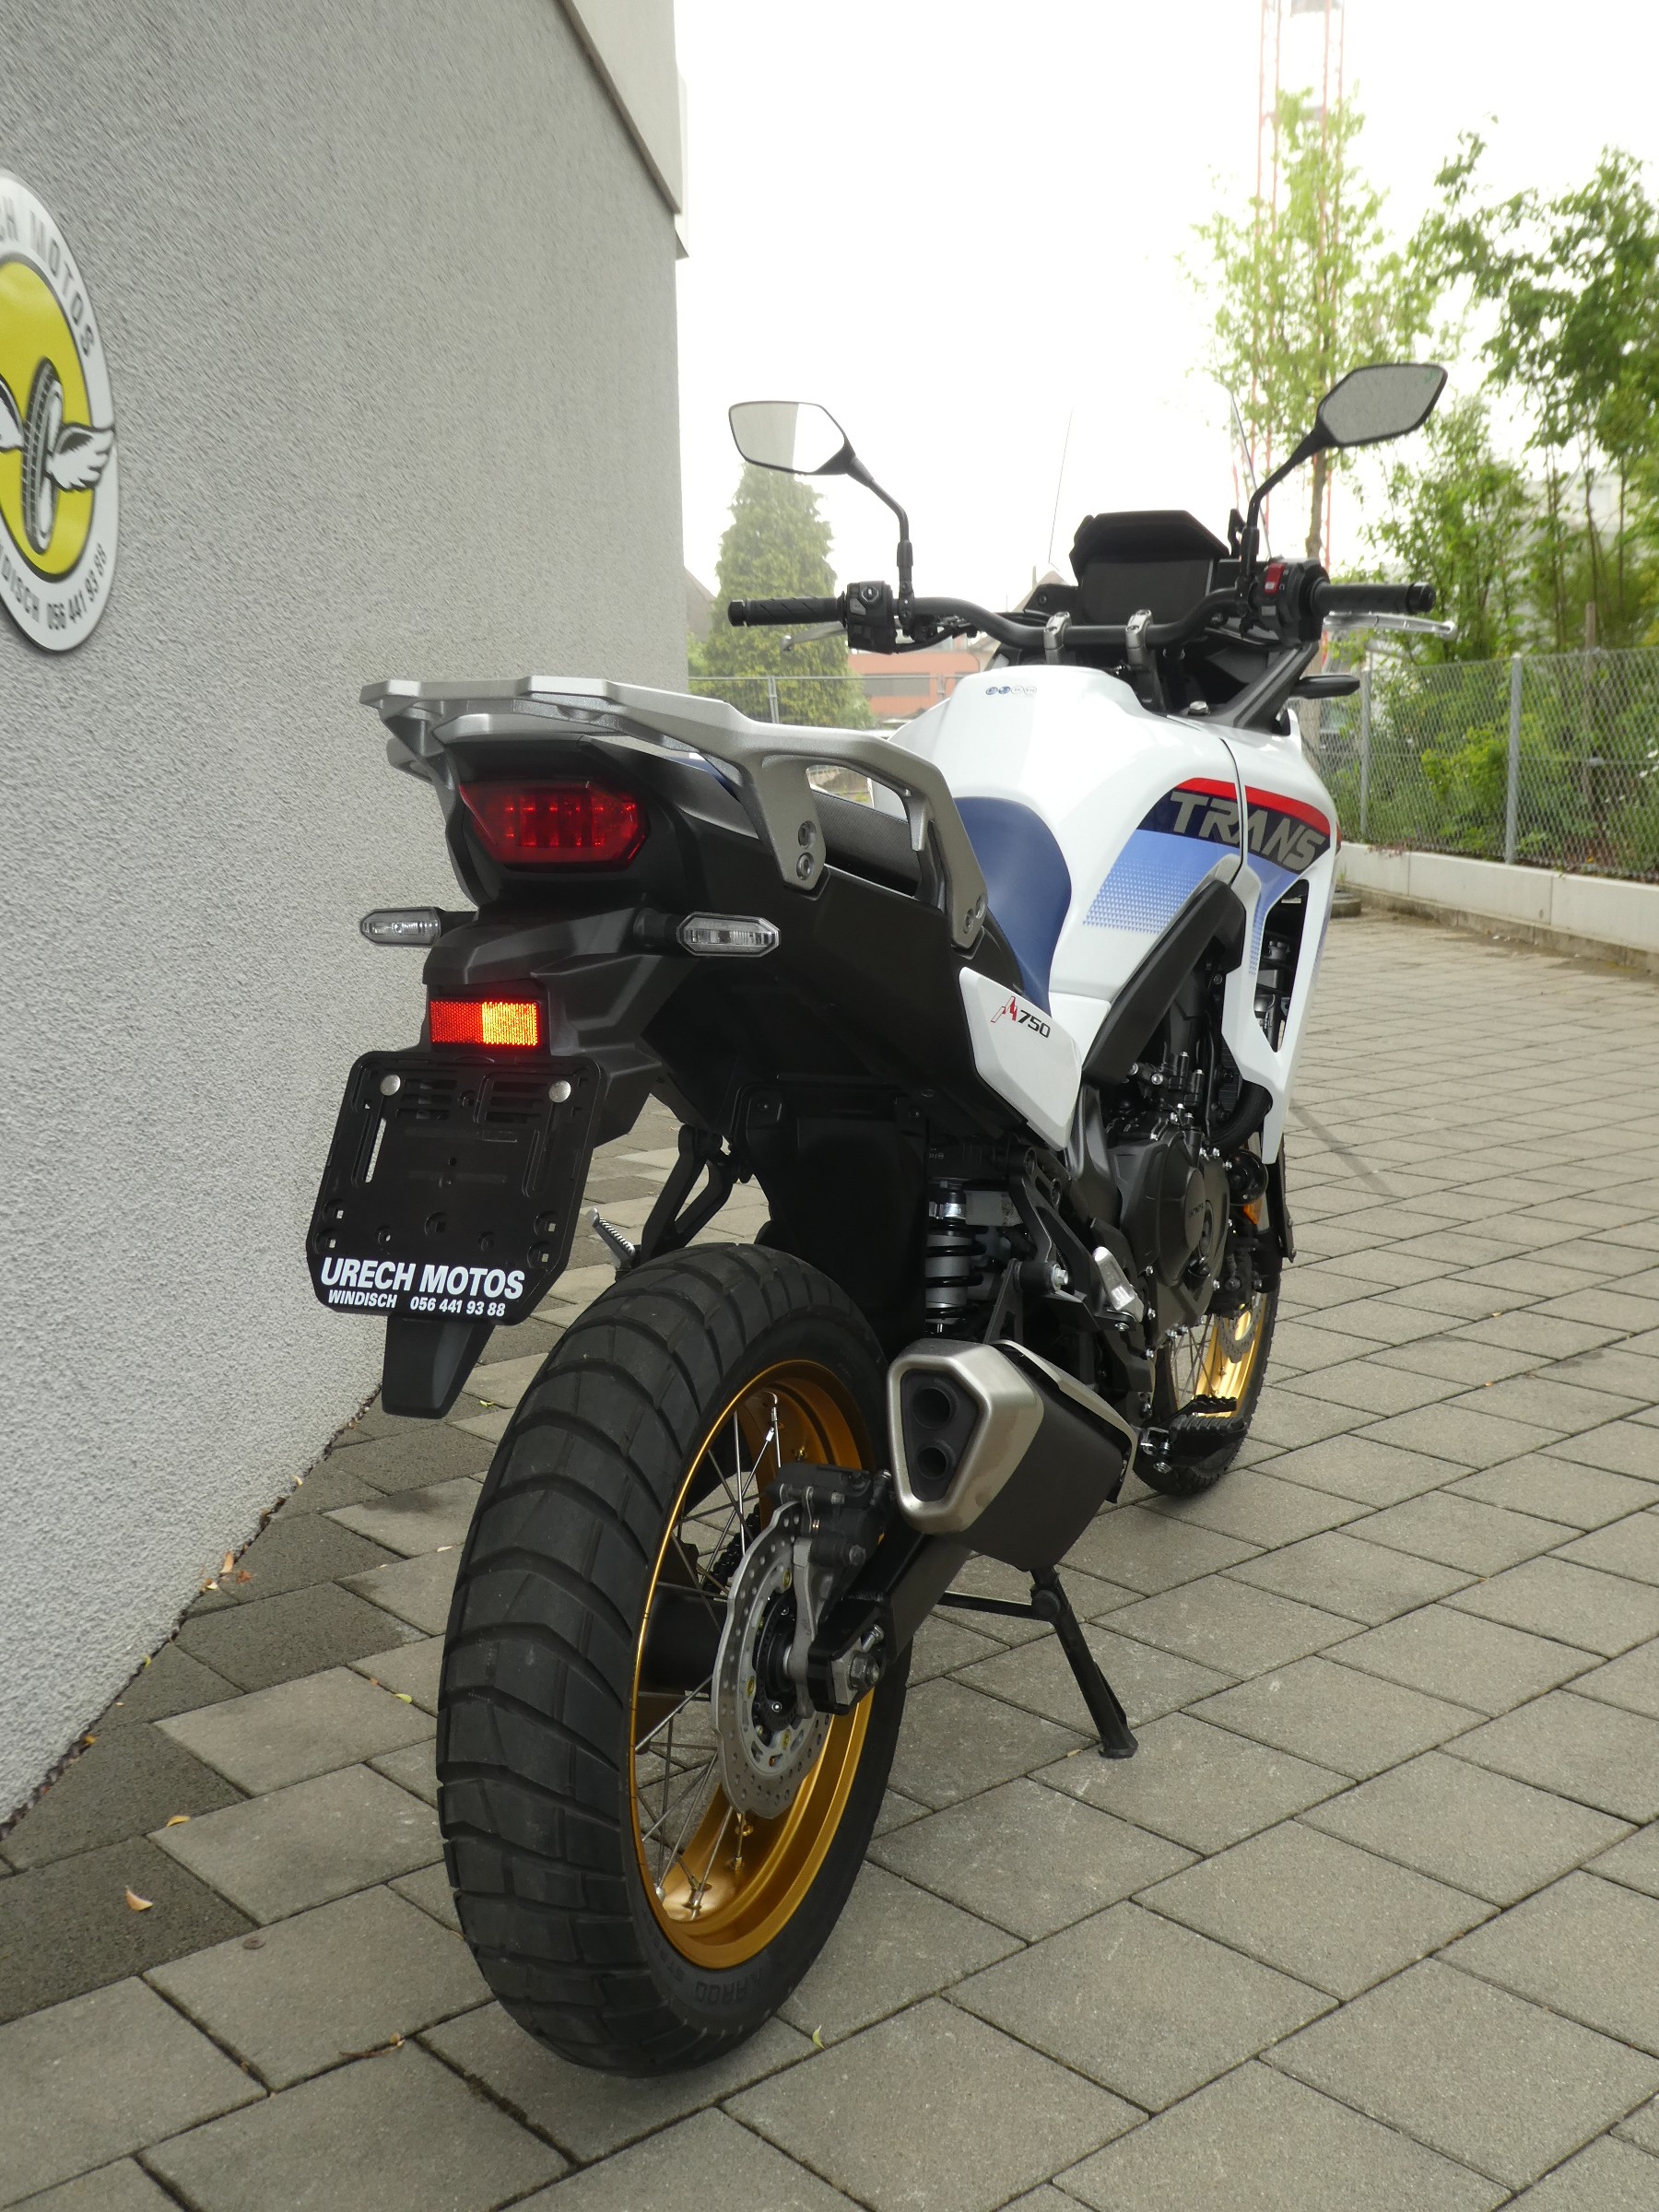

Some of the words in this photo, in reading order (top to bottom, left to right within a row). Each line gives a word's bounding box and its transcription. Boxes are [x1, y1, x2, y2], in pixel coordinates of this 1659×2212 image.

[29, 210, 95, 357] MOTOS
[0, 543, 40, 623] DISCH
[47, 602, 67, 630] 056
[68, 590, 88, 624] 441
[85, 569, 99, 603] 93
[94, 542, 107, 577] 88
[1170, 791, 1326, 871] TRANS
[321, 1257, 417, 1290] URECH
[418, 1265, 525, 1300] MOTOS
[328, 1289, 397, 1309] WINDISCH
[409, 1296, 436, 1312] 056
[439, 1298, 463, 1313] 441
[466, 1300, 486, 1315] 93
[487, 1301, 506, 1317] 88
